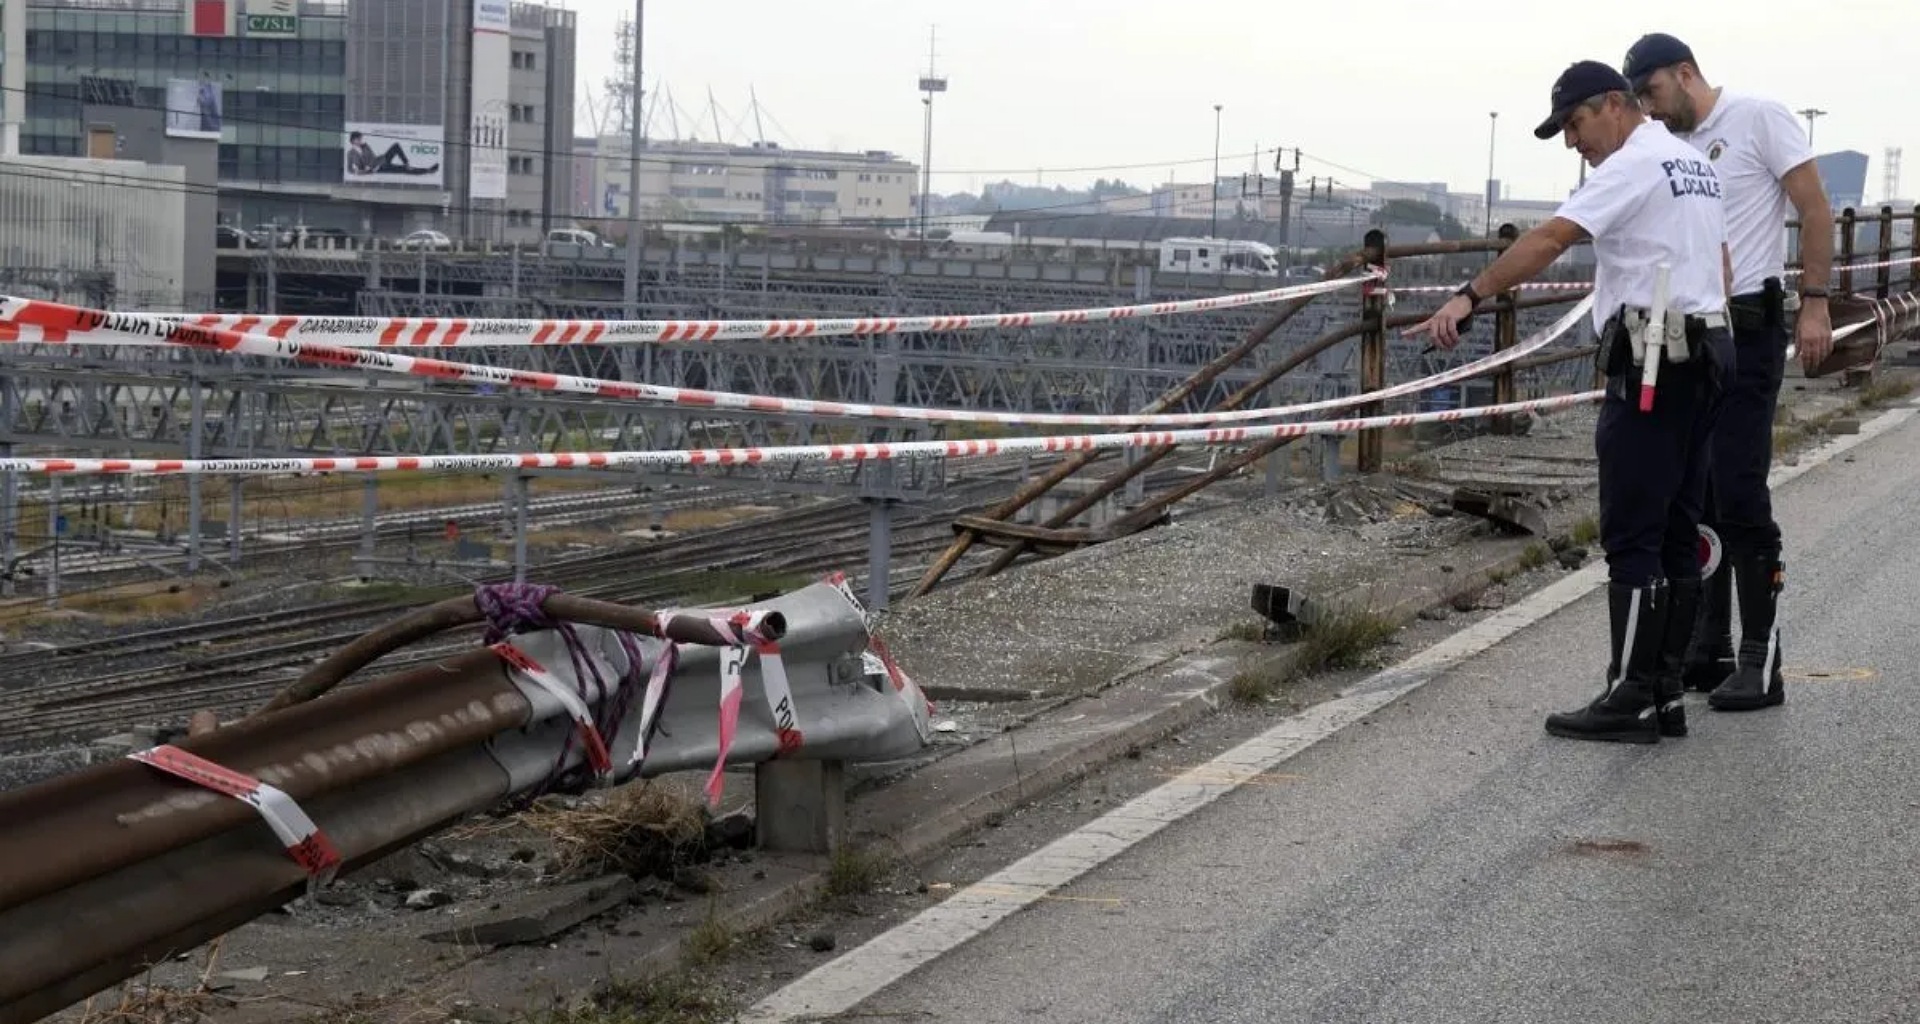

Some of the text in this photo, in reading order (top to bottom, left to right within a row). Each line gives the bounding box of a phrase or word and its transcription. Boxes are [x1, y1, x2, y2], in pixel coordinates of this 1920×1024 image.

[410, 142, 439, 155] nico
[1661, 158, 1718, 179] POLIZIA
[1669, 177, 1722, 199] LOCALE
[299, 318, 379, 333] CARABINIERI
